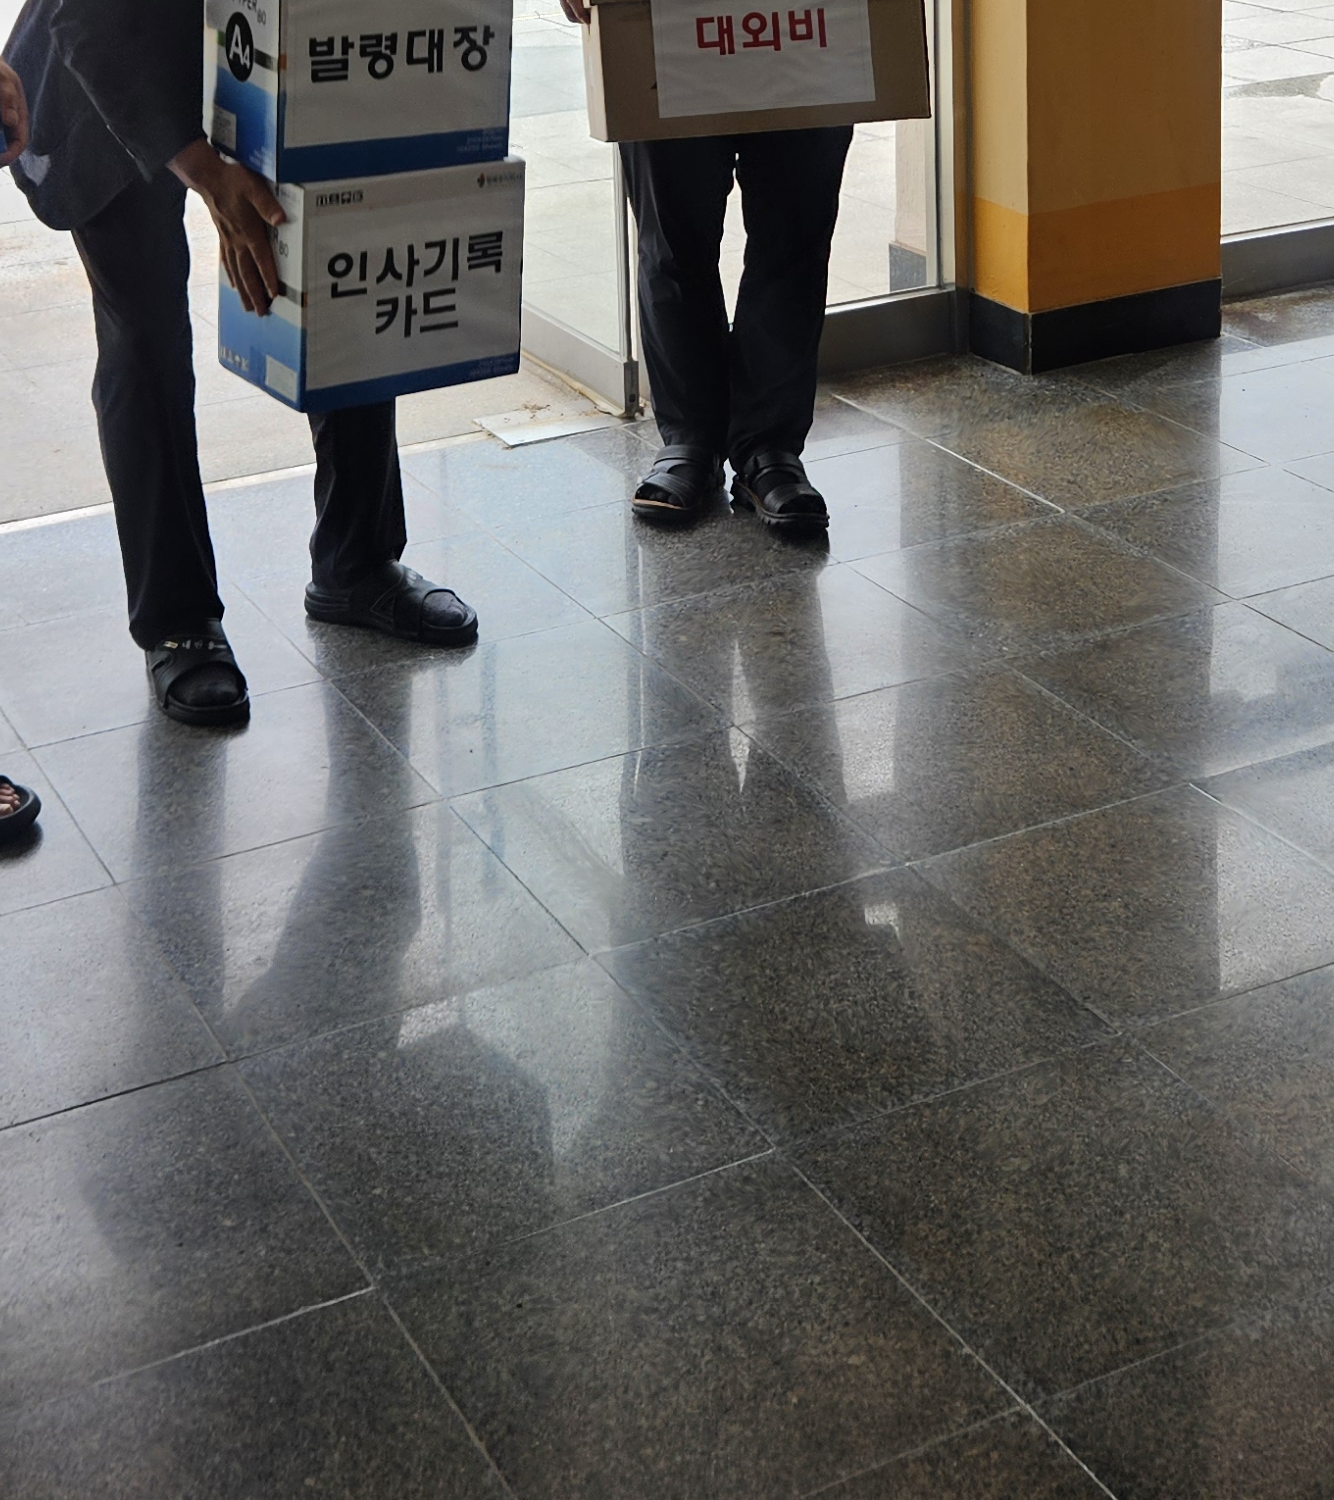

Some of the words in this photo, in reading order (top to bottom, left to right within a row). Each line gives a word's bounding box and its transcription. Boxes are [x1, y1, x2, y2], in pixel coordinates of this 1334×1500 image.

[229, 23, 251, 70] A4
[307, 25, 495, 84] 발령대장
[696, 8, 827, 56] 대외비
[327, 230, 504, 299] 인사기록
[375, 287, 460, 339] 카드
